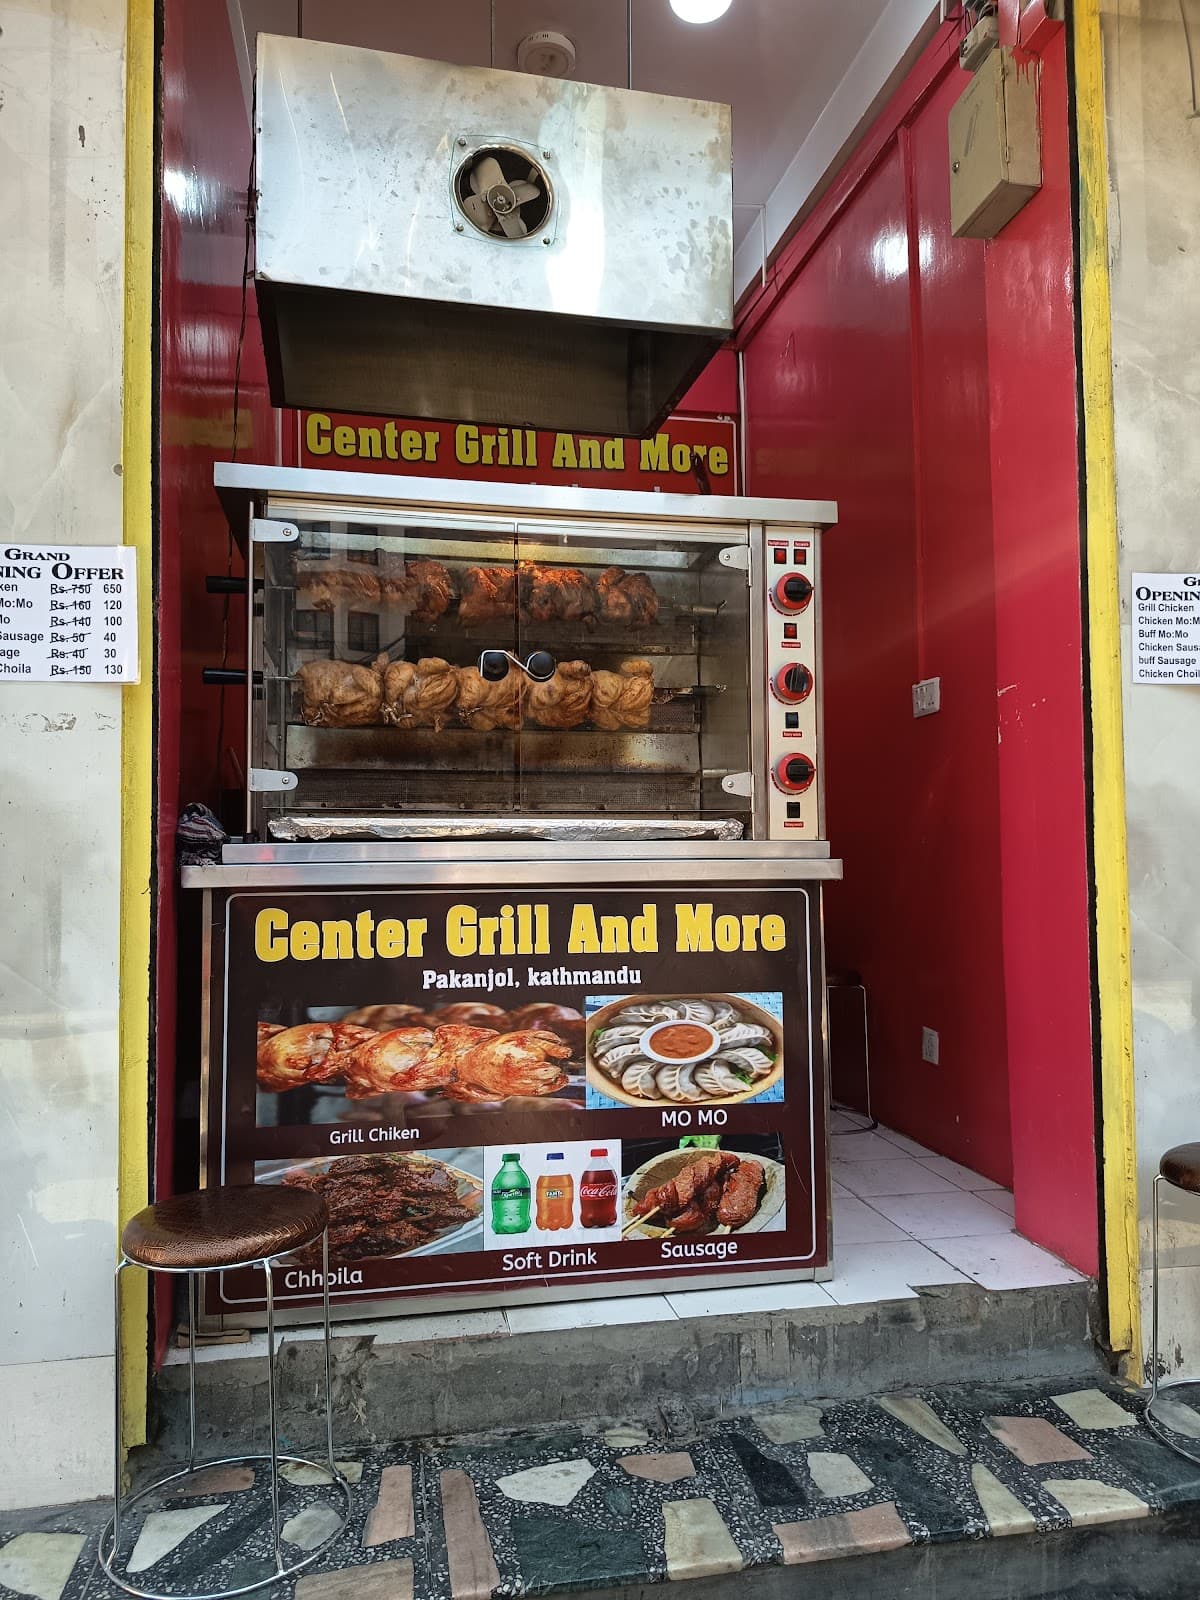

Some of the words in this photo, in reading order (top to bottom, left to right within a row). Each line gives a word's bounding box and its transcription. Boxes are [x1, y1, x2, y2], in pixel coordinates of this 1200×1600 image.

[306, 413, 440, 462] Center
[455, 424, 538, 466] Grill
[552, 433, 626, 470] And
[4, 548, 70, 562] GRAND
[0, 565, 41, 579] ING
[51, 562, 125, 580] OFFER
[50, 583, 68, 595] Rs.
[71, 583, 92, 594] 750
[103, 583, 122, 594] 650
[50, 600, 68, 611] Rs.
[72, 600, 91, 610] 160
[103, 600, 122, 610] 120
[1138, 603, 1156, 612] Grill
[1158, 603, 1195, 612] Chicken
[50, 616, 68, 627] Rs.
[72, 616, 91, 626] 140
[104, 616, 122, 626] 100
[1138, 616, 1173, 625] Chicken
[50, 632, 68, 643] Rs.
[72, 632, 85, 642] 50
[103, 632, 117, 642] 40
[1138, 629, 1157, 638] Buff
[1158, 629, 1189, 639] Mo:Mo
[1138, 642, 1174, 651] Chicken
[1176, 643, 1200, 651] Saus
[50, 648, 69, 659] Rs.
[71, 648, 85, 659] 40
[104, 648, 117, 659] 30
[1157, 656, 1197, 667] Sausage
[50, 664, 69, 676] Rs.
[73, 664, 92, 675] 150
[104, 664, 123, 675] 130
[1138, 669, 1174, 678] Chicken
[254, 908, 428, 962] Center
[446, 904, 551, 957] Grill
[567, 903, 659, 954] And
[675, 903, 786, 952] More
[422, 968, 521, 992] Pakanjol,
[527, 965, 642, 987] kathmandu
[661, 1110, 692, 1127] MO
[698, 1109, 728, 1126] MO
[329, 1129, 365, 1145] Grill
[368, 1126, 420, 1142] Chiken
[661, 1241, 738, 1260] Sausage
[502, 1252, 543, 1272] Soft
[548, 1248, 598, 1269] Drink
